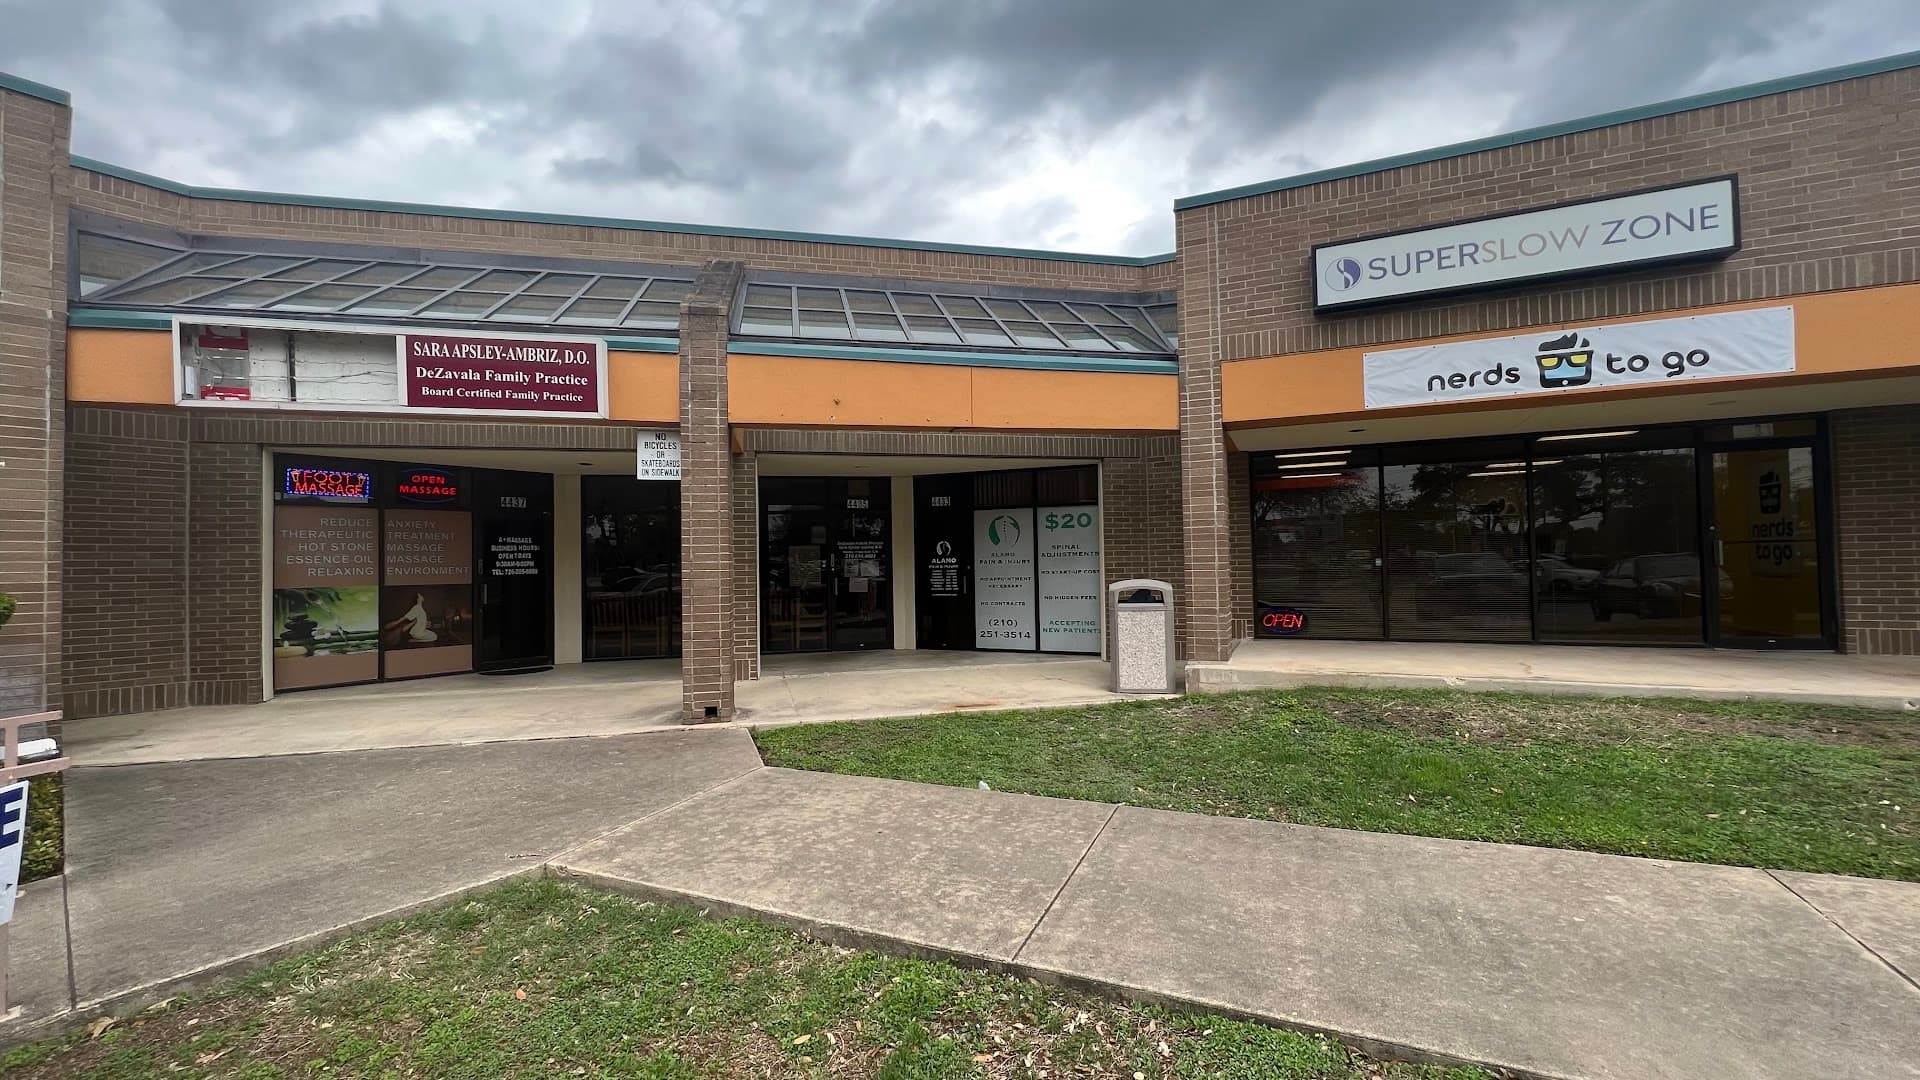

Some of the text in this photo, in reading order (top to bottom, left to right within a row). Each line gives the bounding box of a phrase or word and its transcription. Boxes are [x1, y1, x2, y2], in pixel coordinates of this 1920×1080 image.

[1367, 203, 1720, 281] SUPERSLOW ZONE
[413, 341, 590, 365] SARA APSLEY-AMBRIZ, D.O.
[1427, 347, 1710, 392] nerds to go
[415, 366, 589, 386] DeZavala Family Practice
[421, 386, 584, 402] Board Certified Family Practice
[655, 432, 667, 440] NO
[644, 441, 677, 449] BICYCLES
[656, 450, 665, 459] OR
[641, 459, 680, 468] SKATEBOARDS
[303, 470, 351, 486] FOOT
[641, 468, 680, 477] ON SIDEWALK
[411, 474, 446, 484] OPEN
[294, 482, 363, 497] MASSAGE
[399, 485, 457, 496] MASSAGE
[320, 517, 437, 529] REDUCE ANXIETY
[1045, 512, 1092, 532] $20
[1751, 517, 1794, 538] nerds
[280, 529, 456, 541] THERAPEUTIC TREATMENT
[298, 541, 445, 552] HOT STONE MASSAGE
[286, 554, 446, 565] ESSENCE OIL MASSAGE
[1041, 551, 1100, 559] ADJUSTMENTS
[1755, 544, 1793, 566] to go
[307, 566, 470, 577] RELAXING ENVIRONMENT
[988, 619, 1018, 627] (210)
[1262, 613, 1304, 628] OPEN
[979, 630, 1031, 639] 251-3514
